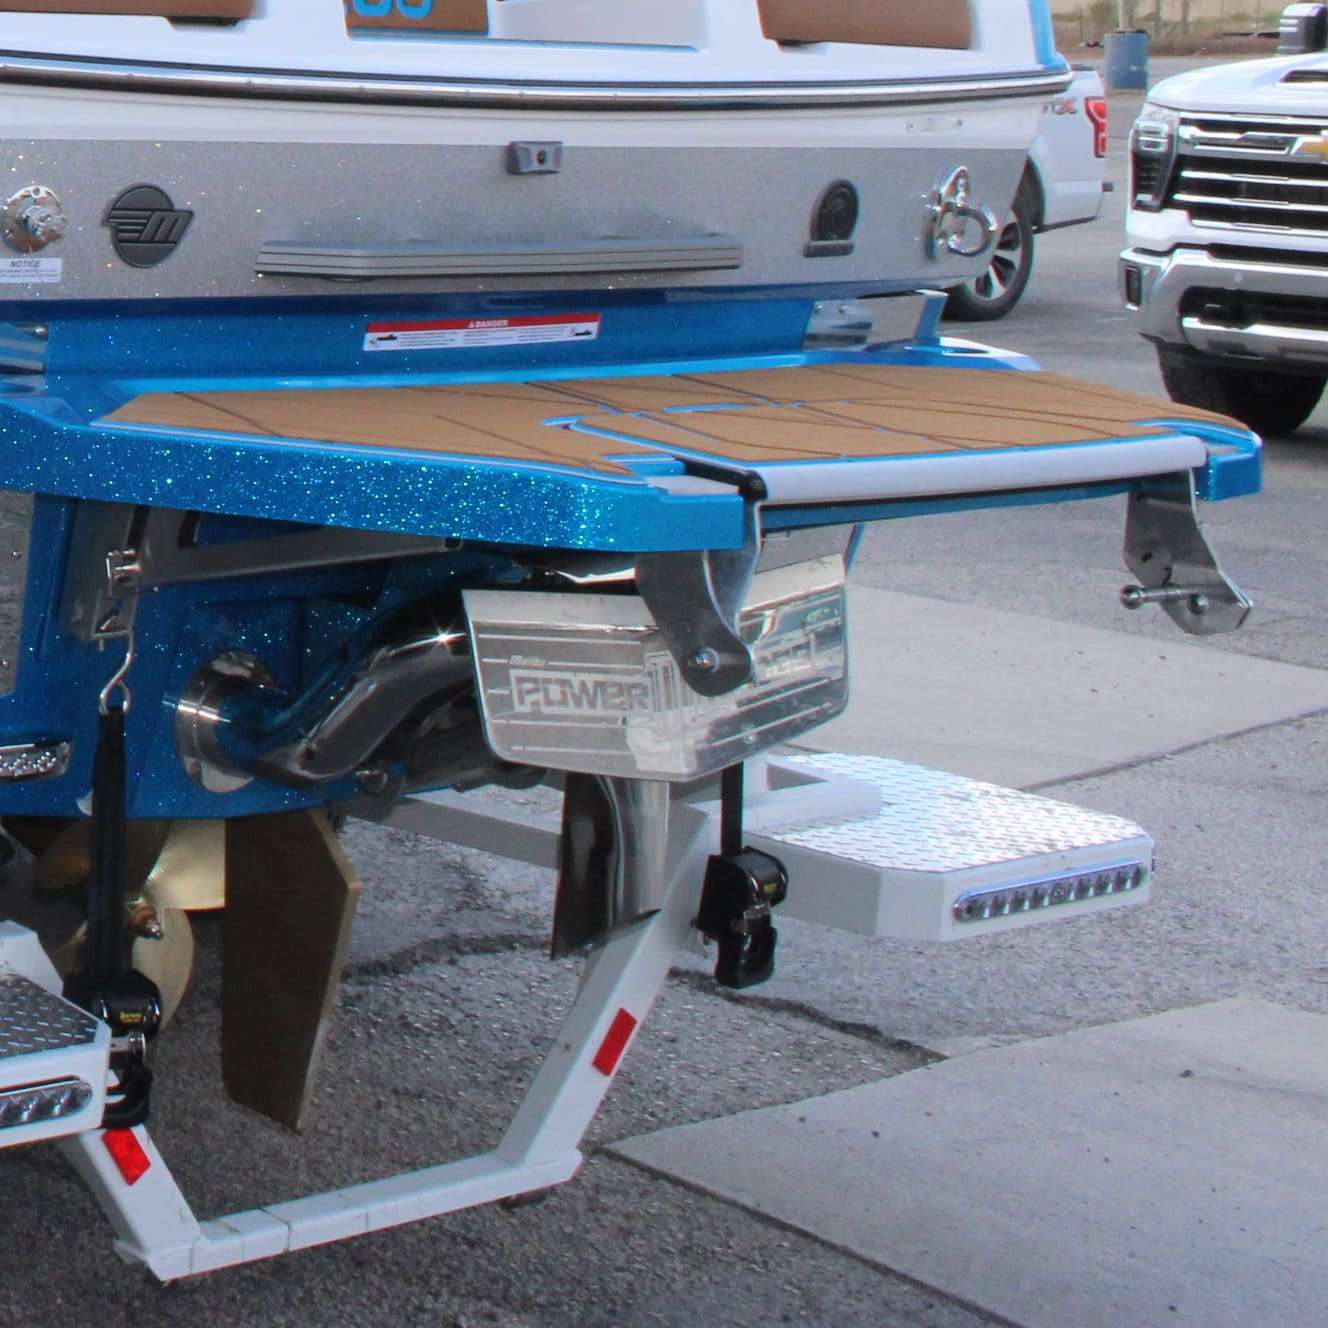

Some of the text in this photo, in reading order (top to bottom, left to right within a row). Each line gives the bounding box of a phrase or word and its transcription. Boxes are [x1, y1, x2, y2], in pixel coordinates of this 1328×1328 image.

[9, 260, 41, 268] NOTICE
[475, 319, 509, 328] DANGER
[516, 676, 648, 710] POWER
